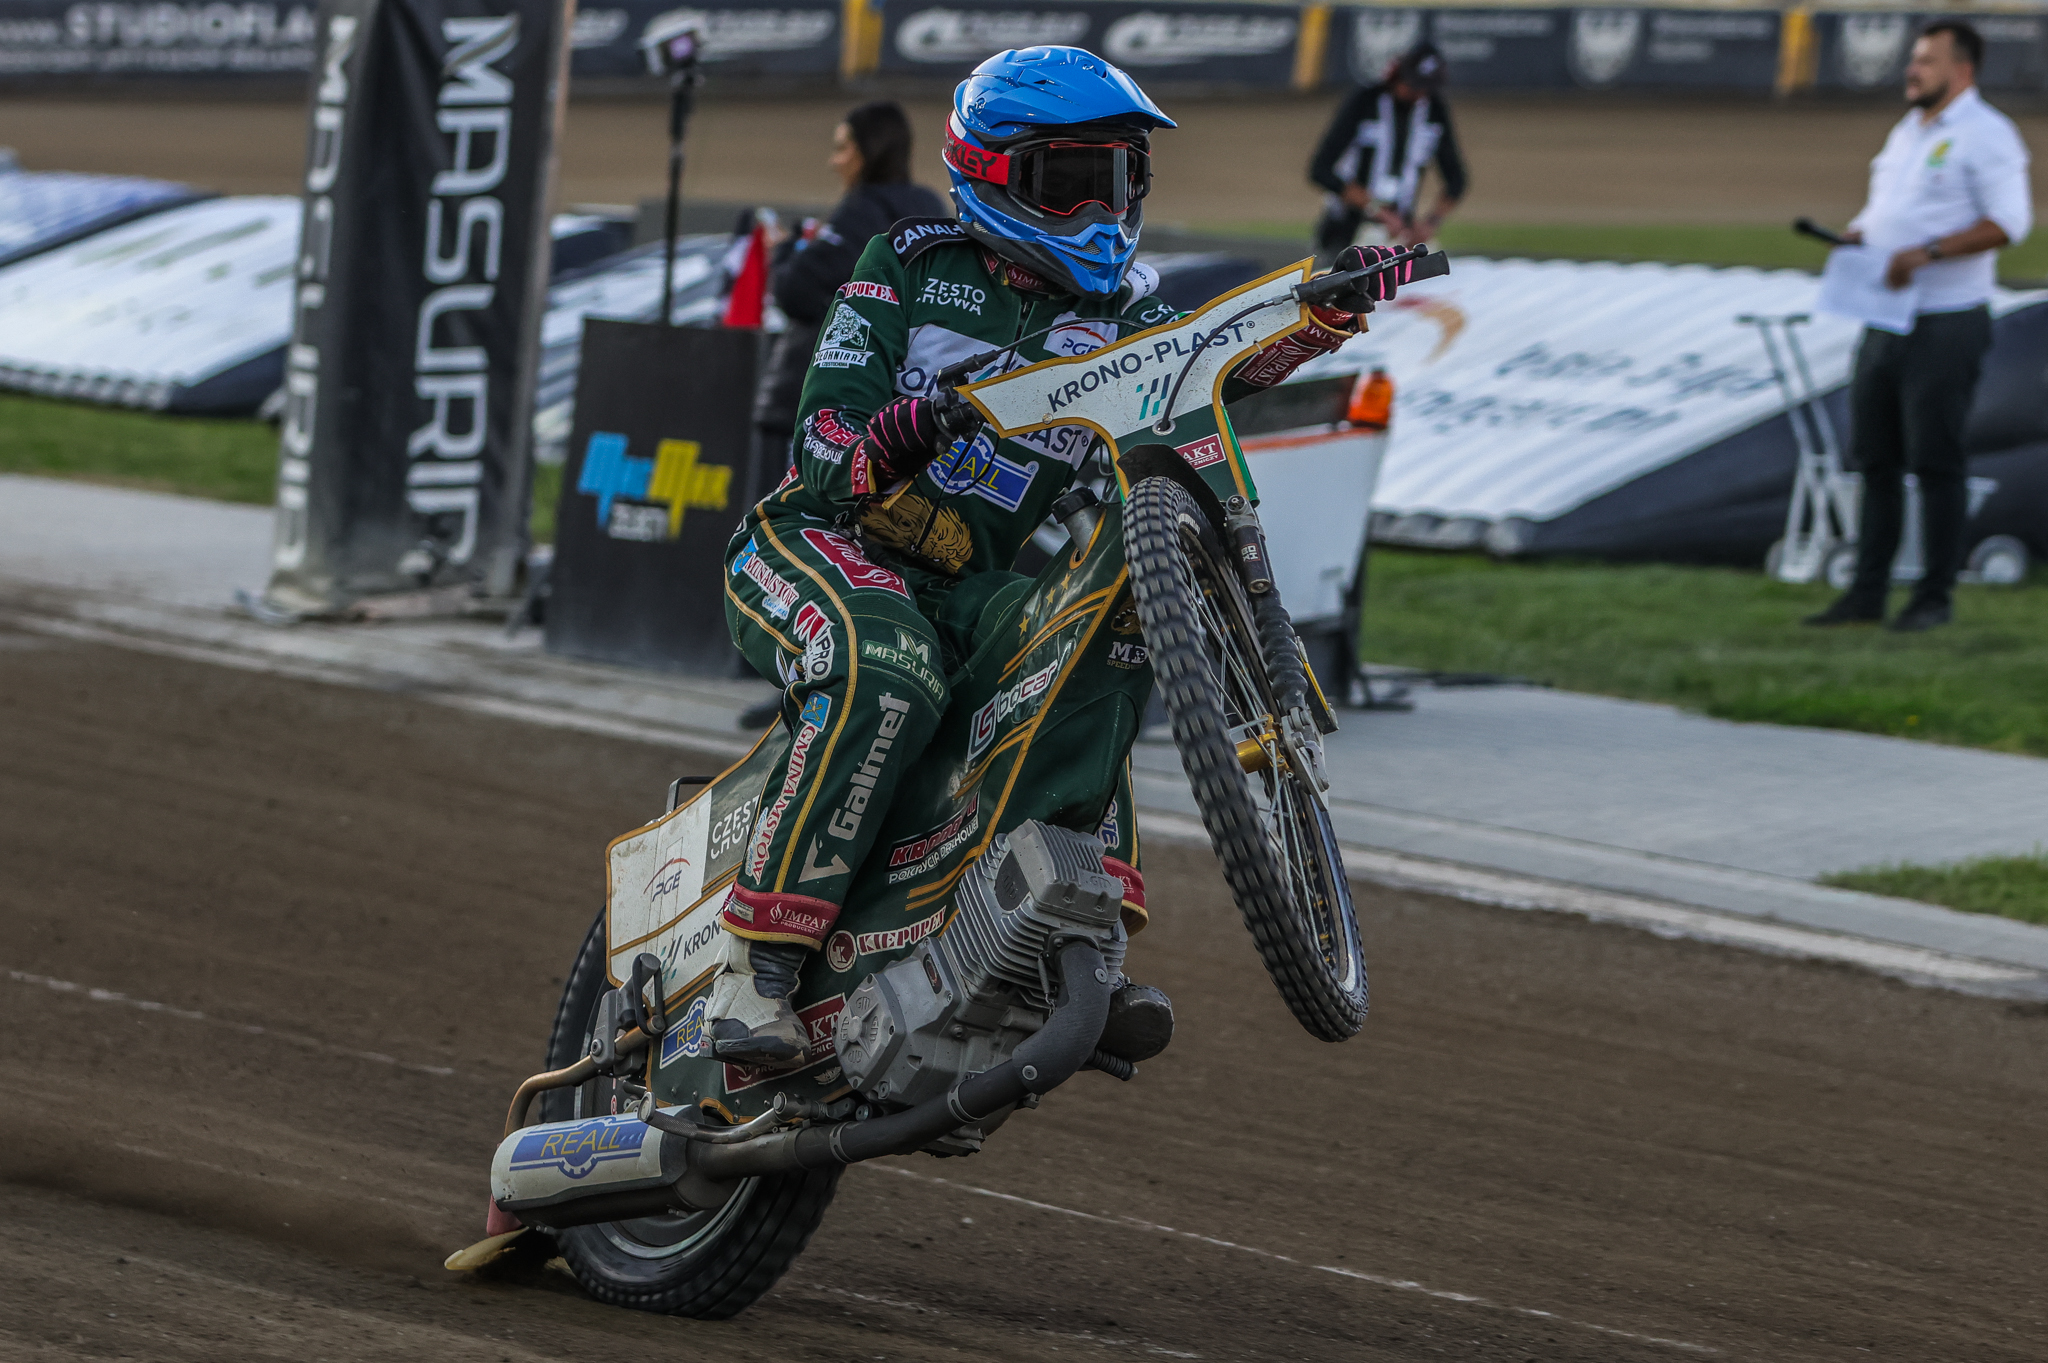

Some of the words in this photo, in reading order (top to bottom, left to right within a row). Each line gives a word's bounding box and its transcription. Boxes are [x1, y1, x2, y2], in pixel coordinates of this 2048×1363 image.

[935, 445, 1000, 491] EALL
[865, 644, 945, 700] MASURIA
[1106, 660, 1142, 670] SPEED
[783, 725, 815, 796] GMINA
[827, 692, 911, 841] Galmet
[752, 798, 788, 884] MSTÓW
[652, 870, 682, 903] PGE
[683, 919, 725, 960] KRON
[783, 908, 831, 930] IMPAK
[540, 1126, 622, 1158] REALL
